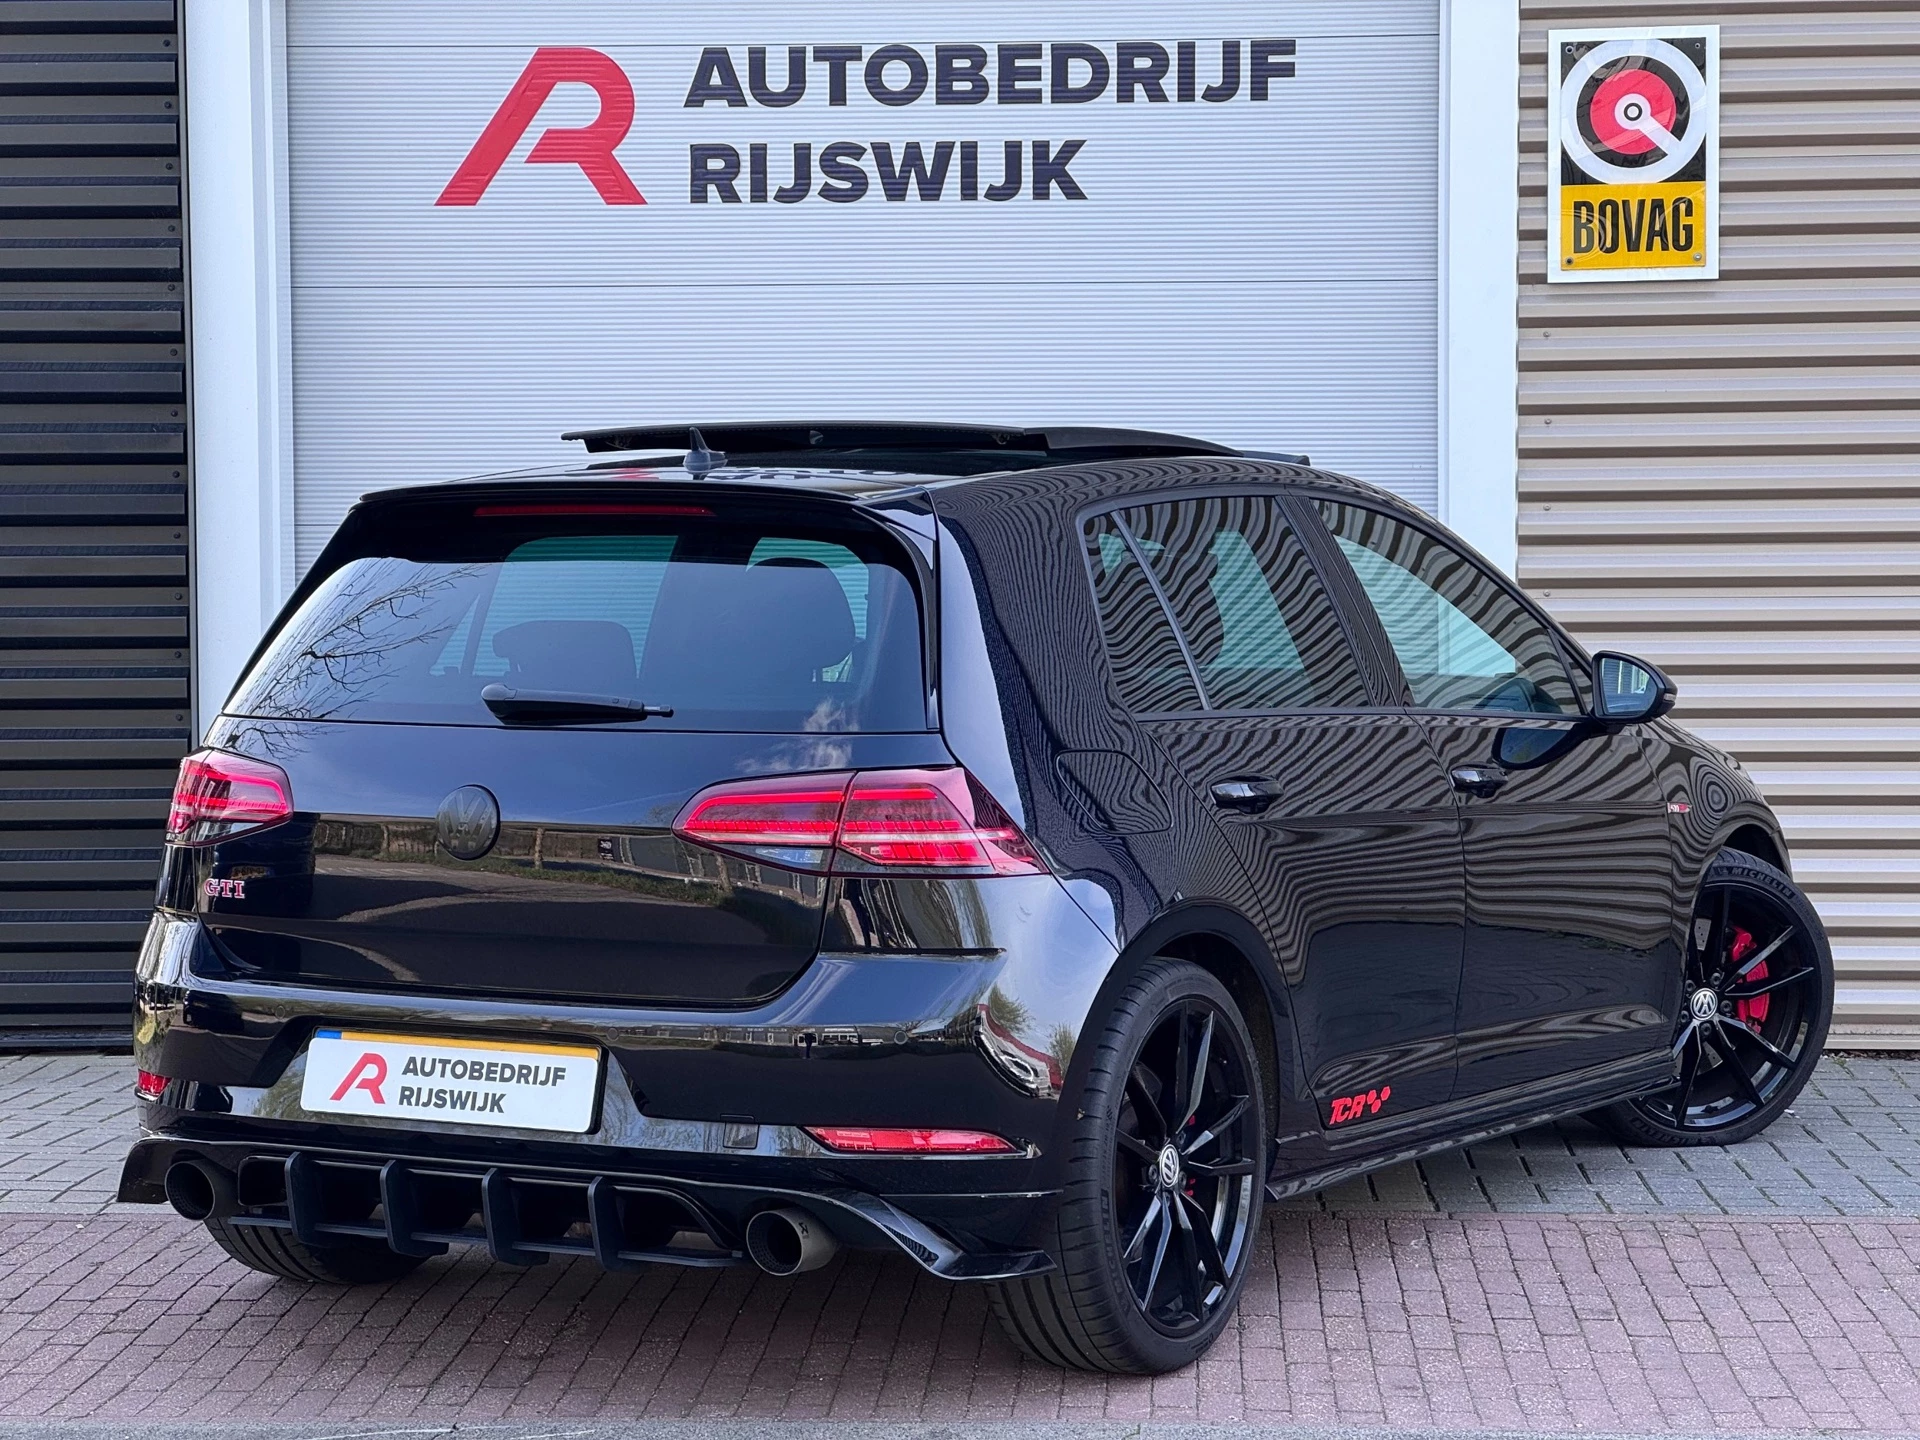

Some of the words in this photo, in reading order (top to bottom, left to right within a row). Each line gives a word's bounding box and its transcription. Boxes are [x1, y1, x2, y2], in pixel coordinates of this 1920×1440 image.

[684, 40, 1296, 108] AUTOBEDRIJF
[689, 139, 1087, 204] RIJSWIJK
[1573, 196, 1694, 254] BOVAG
[204, 878, 245, 899] GTI
[1731, 867, 1793, 898] MICHELIN
[402, 1056, 567, 1088] AUTOBEDRIJF
[398, 1086, 507, 1114] RIJSWIJK
[1101, 1194, 1124, 1294] MICHELIN
